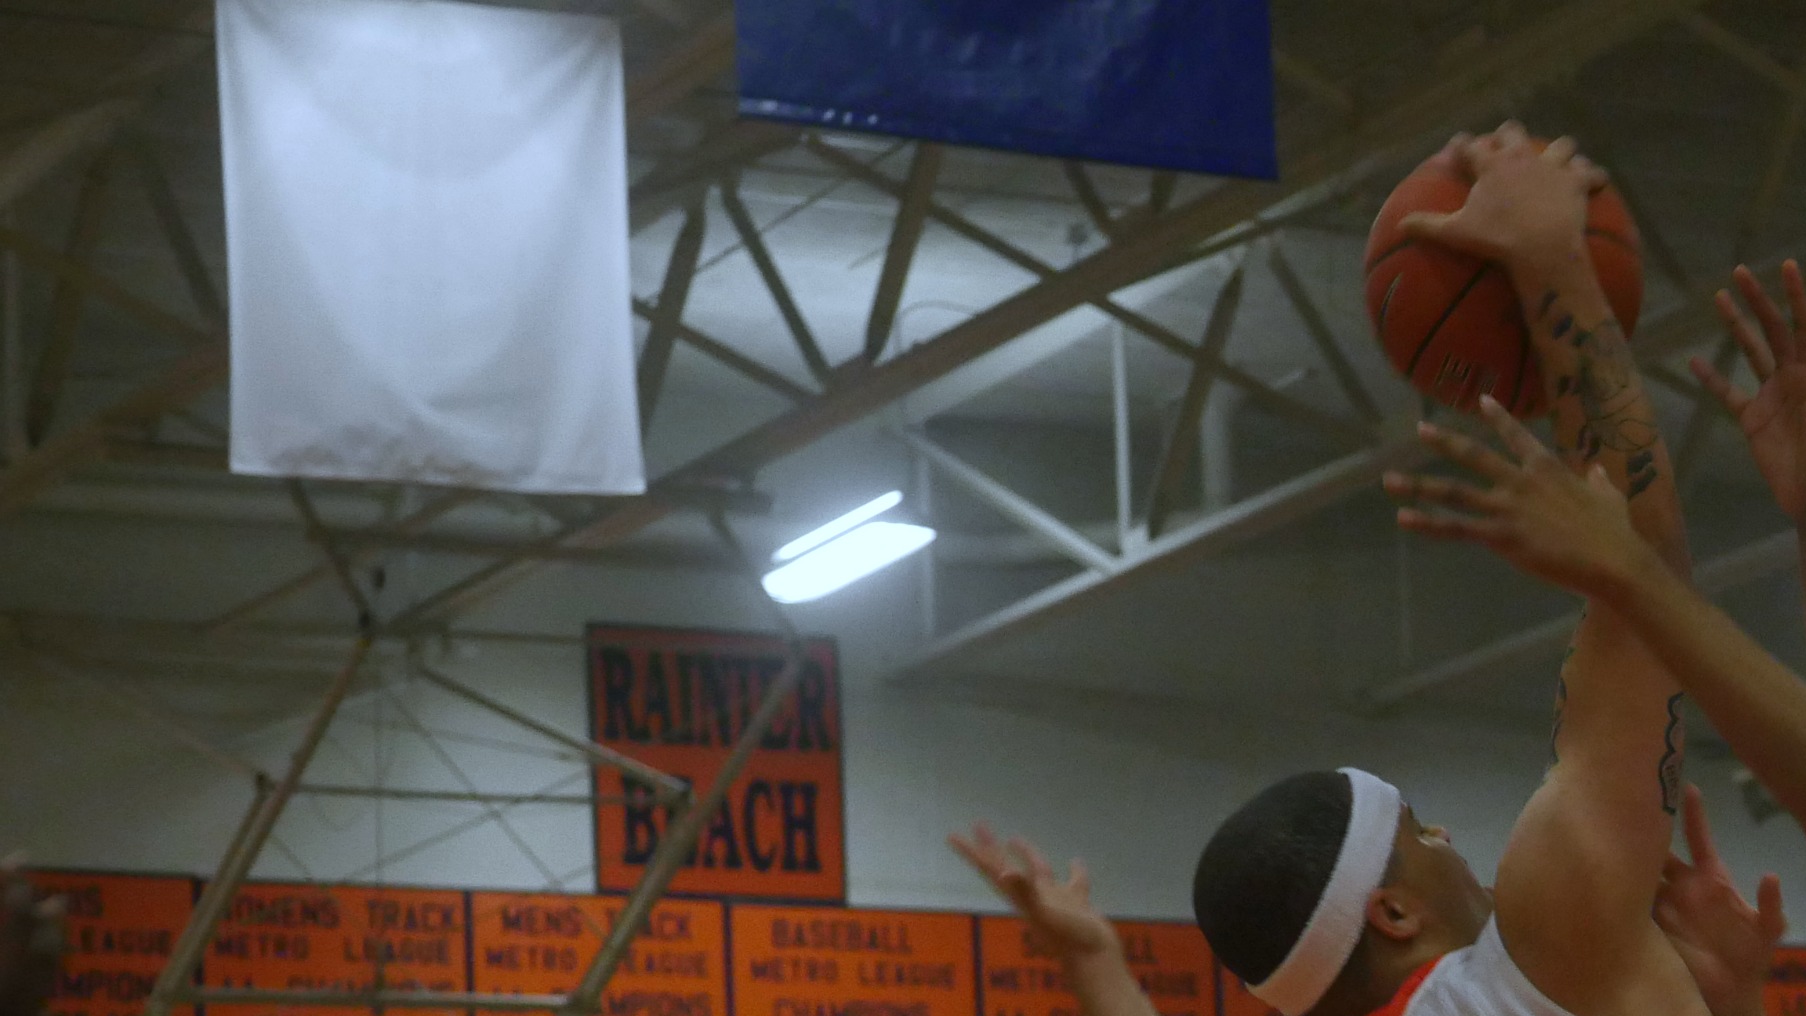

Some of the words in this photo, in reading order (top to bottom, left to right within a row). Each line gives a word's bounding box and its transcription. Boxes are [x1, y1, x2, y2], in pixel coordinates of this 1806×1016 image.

[366, 898, 460, 932] TRACK
[501, 906, 584, 938] MENS
[215, 932, 310, 960] METRO
[771, 918, 913, 954] BASEBALL
[485, 946, 576, 973] METRO
[750, 955, 838, 983] METRO
[858, 960, 956, 989] LEAGUE
